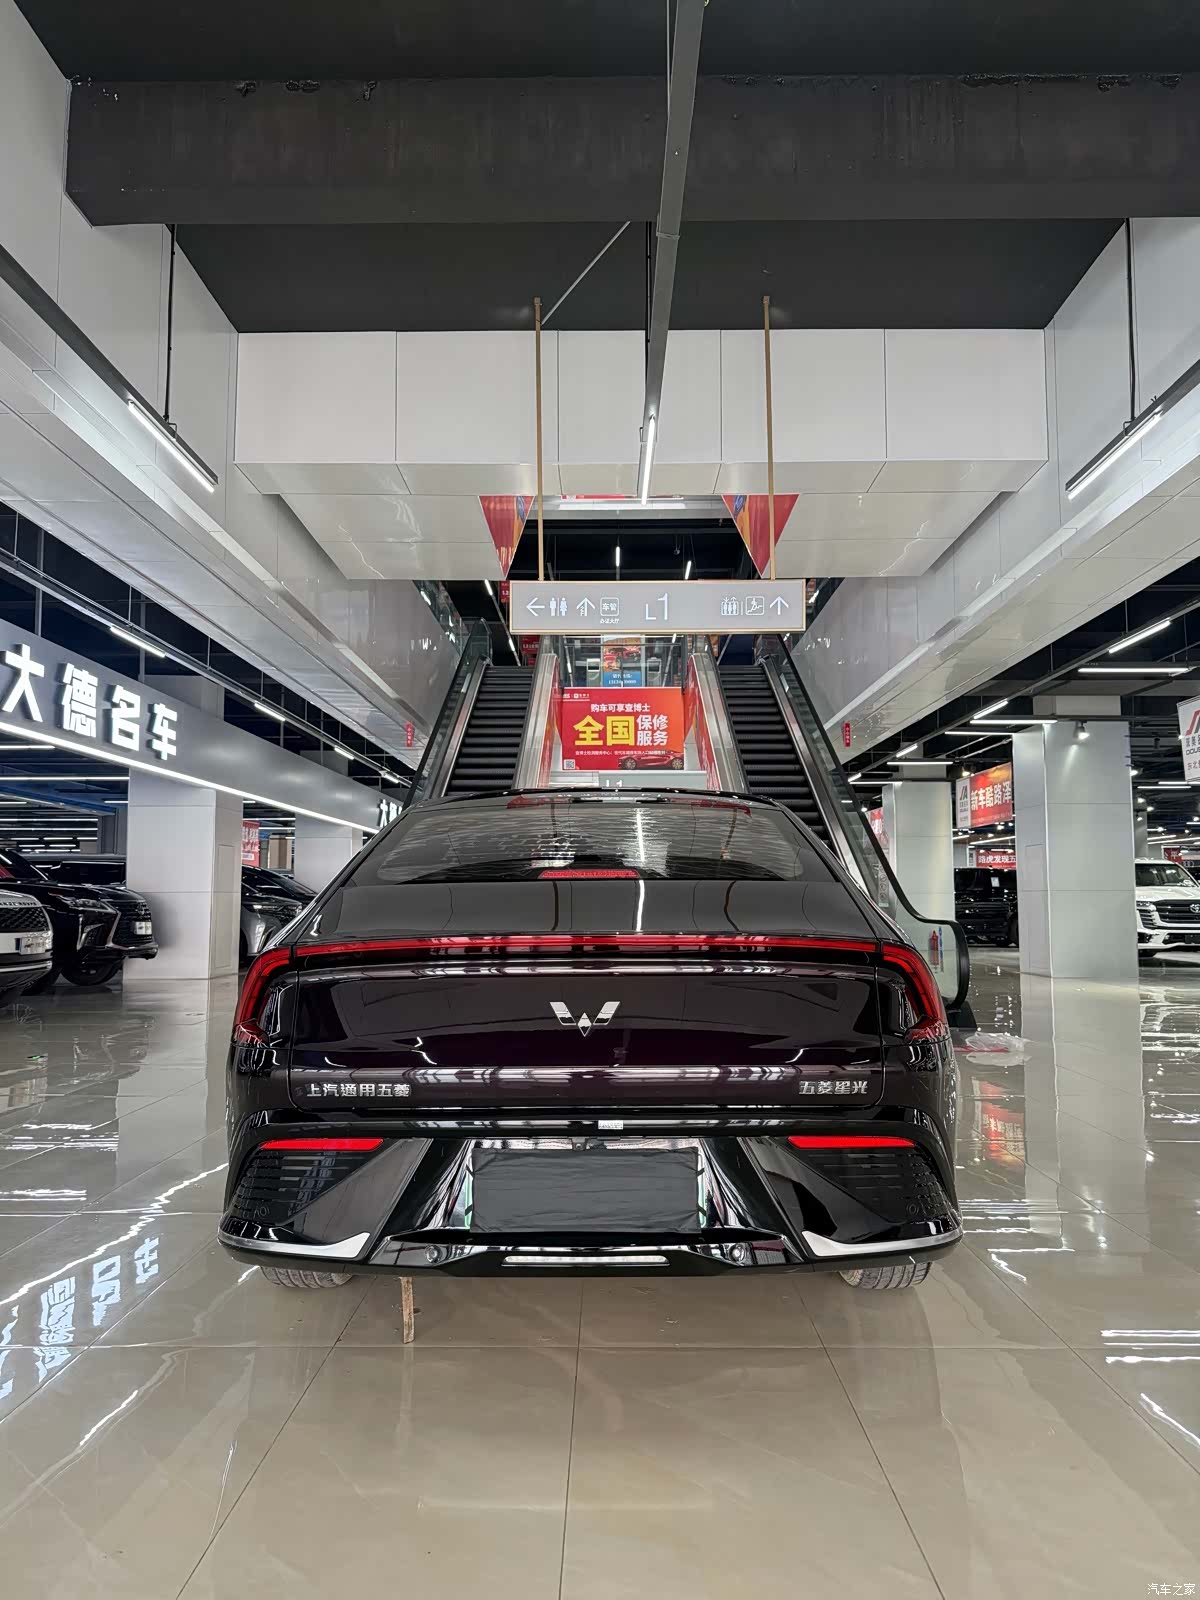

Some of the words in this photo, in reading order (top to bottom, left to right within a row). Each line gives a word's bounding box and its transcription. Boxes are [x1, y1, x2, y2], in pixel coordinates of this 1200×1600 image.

[645, 593, 668, 620] L1
[2, 643, 178, 761] 大德名车
[590, 703, 651, 713] 购车可享查博士
[573, 715, 635, 746] 全国
[636, 714, 669, 731] 保修
[636, 731, 669, 747] 服务
[970, 781, 1012, 811] 新车酷路泽
[306, 1083, 411, 1097] 上汽通用五菱
[798, 1080, 868, 1095] 五菱星光
